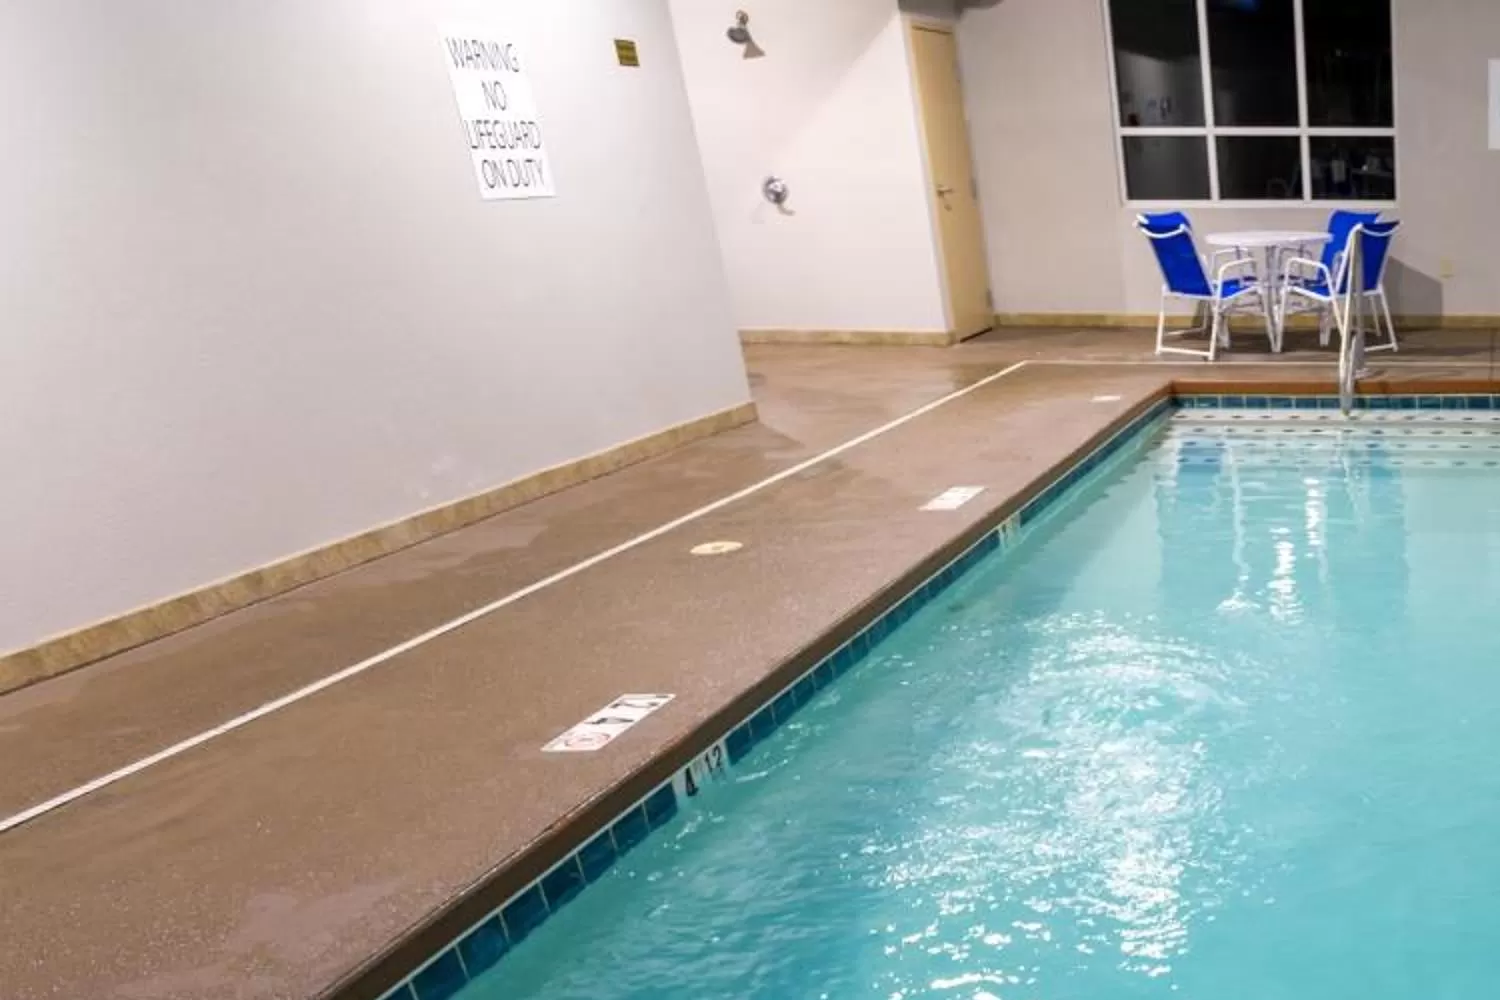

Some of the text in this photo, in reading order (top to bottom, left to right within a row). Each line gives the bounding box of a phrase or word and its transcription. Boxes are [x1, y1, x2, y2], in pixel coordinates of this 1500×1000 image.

[444, 37, 520, 73] WARNING
[481, 80, 507, 111] NO
[462, 119, 543, 150] LIFEGUARD
[480, 158, 545, 188] ON DUTY
